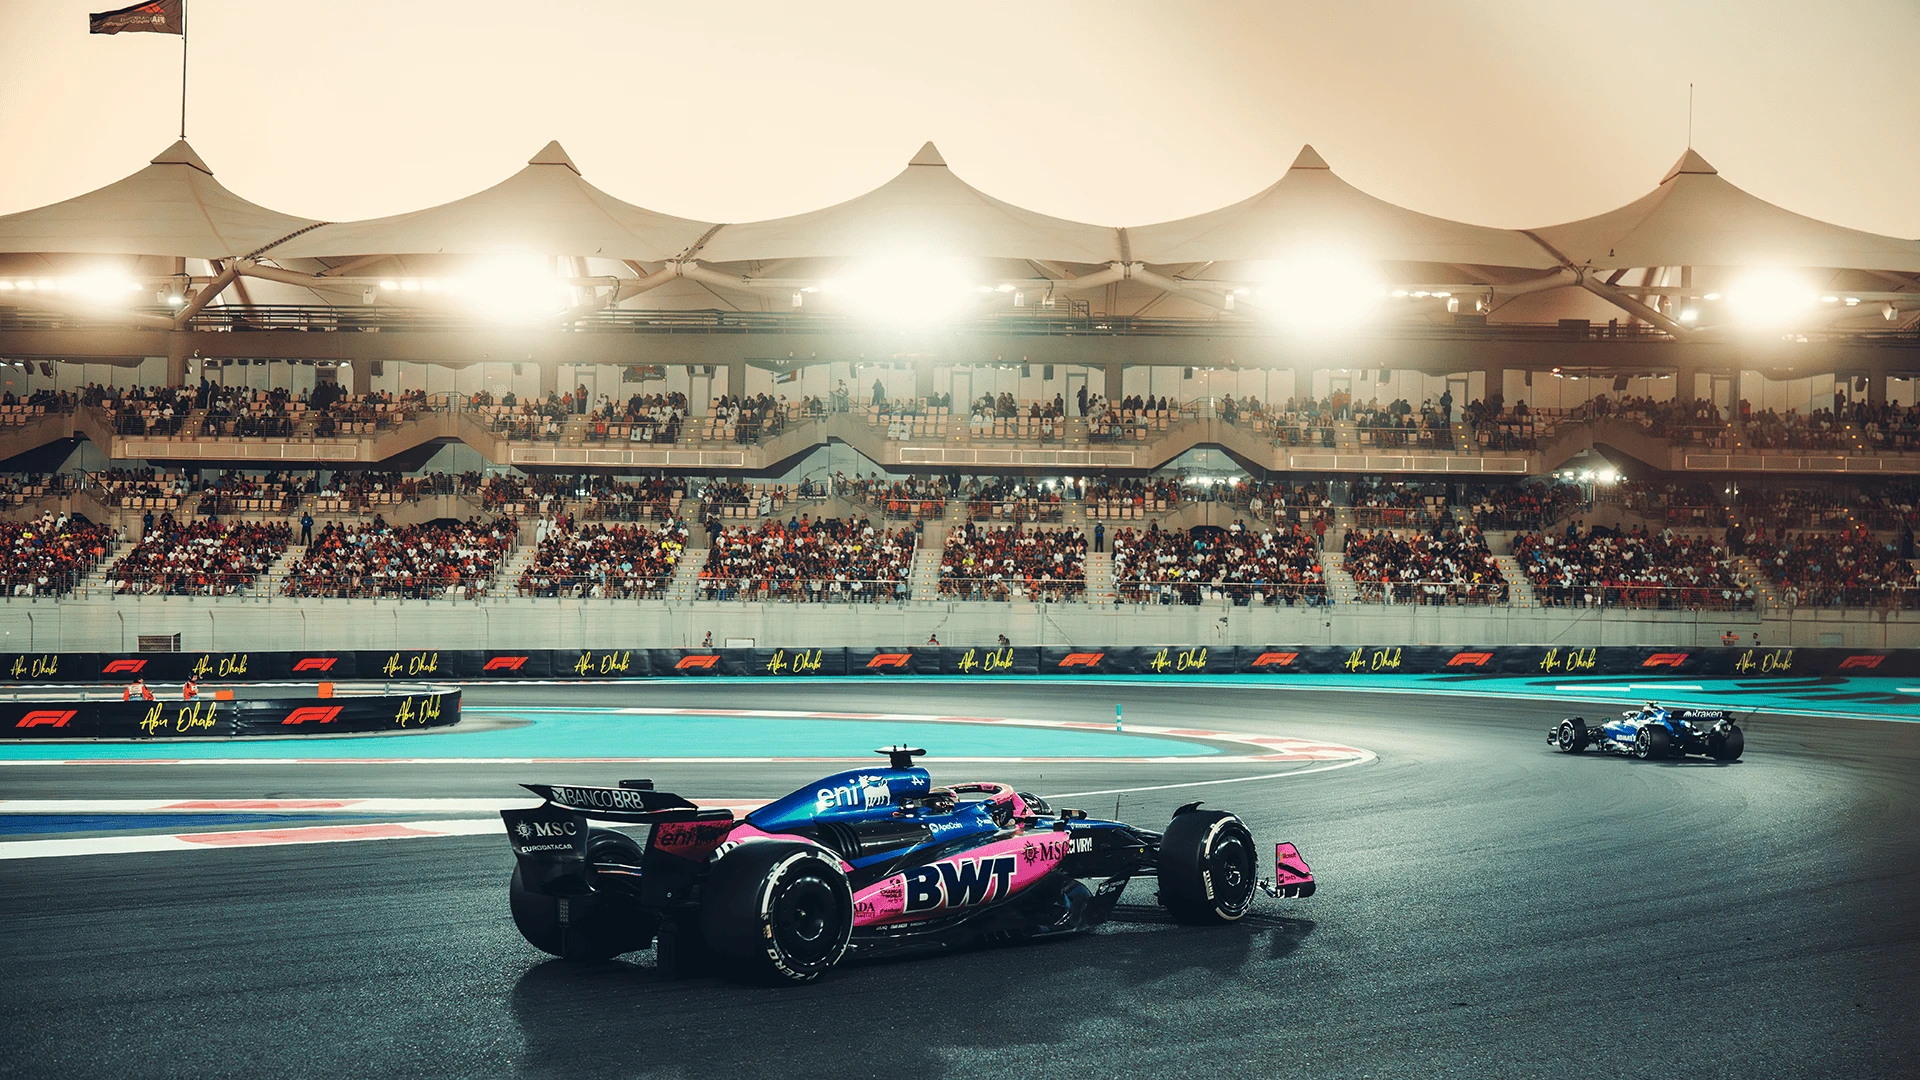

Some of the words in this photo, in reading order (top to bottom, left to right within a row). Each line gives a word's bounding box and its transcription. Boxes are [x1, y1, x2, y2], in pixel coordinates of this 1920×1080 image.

[10, 655, 27, 676] Abu
[32, 655, 58, 677] Dhabi
[192, 654, 213, 676] Abu
[219, 653, 248, 678] Dhabi
[383, 654, 403, 677] Abu
[409, 651, 439, 676] Dhabi
[574, 651, 594, 676] Abu
[599, 651, 630, 676] Dhabi
[765, 649, 787, 675] Abu
[793, 649, 822, 674] Dhabi
[957, 648, 979, 674] Abu
[983, 647, 1014, 672] Dhabi
[1150, 649, 1171, 673] Abu
[1177, 647, 1207, 672] Dhabi
[1344, 648, 1367, 672] Abu
[1371, 647, 1401, 671] Dhabi
[1539, 648, 1561, 671] Abu
[1565, 647, 1596, 671] Dhabi
[1735, 649, 1756, 671] Abu
[1762, 648, 1792, 671] Dhabi
[15, 709, 78, 729] F1
[139, 702, 170, 735] Abu
[175, 701, 218, 733] Dhabi
[281, 705, 344, 725] F1
[395, 696, 415, 728] Abu
[418, 694, 441, 724] Dhabi
[567, 789, 644, 809] BANCOBRB
[816, 779, 859, 808] eni
[536, 822, 577, 836] MSC
[661, 825, 693, 847] eni
[521, 844, 573, 853] EURODATACAR
[903, 855, 1017, 914] BWT
